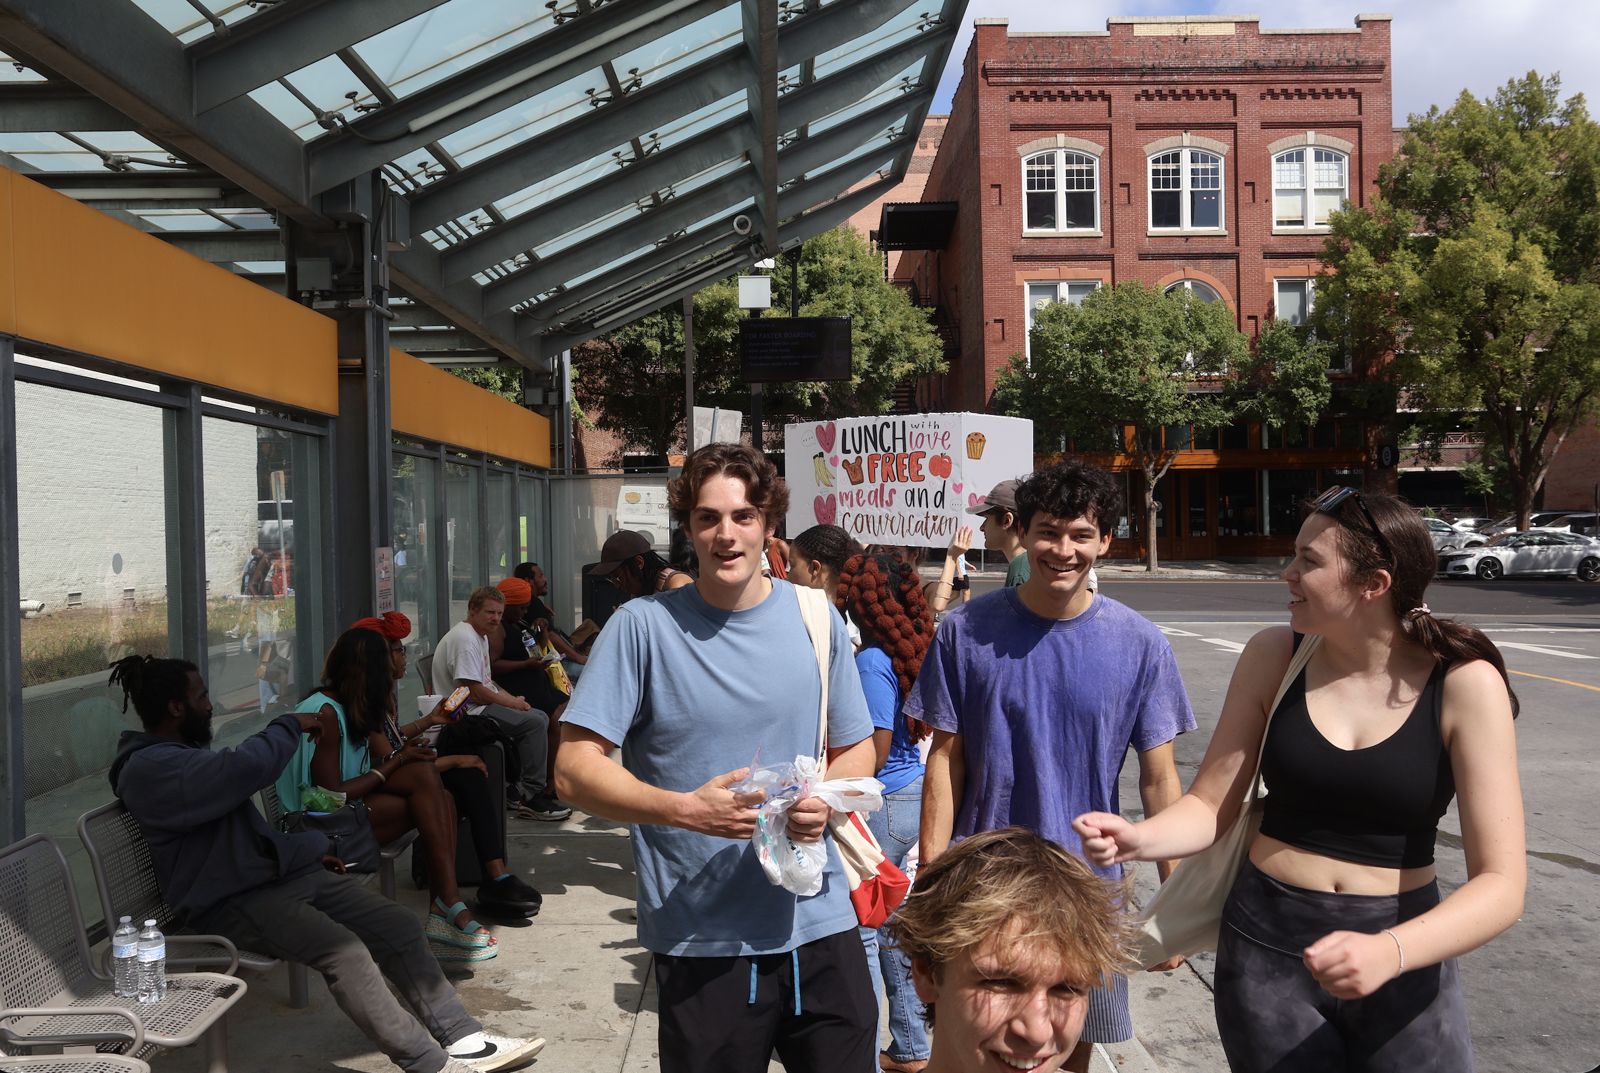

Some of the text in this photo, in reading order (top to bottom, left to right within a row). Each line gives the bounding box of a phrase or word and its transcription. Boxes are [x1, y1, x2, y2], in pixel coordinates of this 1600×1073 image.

[841, 420, 907, 454] LUNCH
[909, 430, 951, 450] love
[910, 421, 940, 430] with
[867, 451, 926, 483] FREE
[839, 480, 947, 509] meals and
